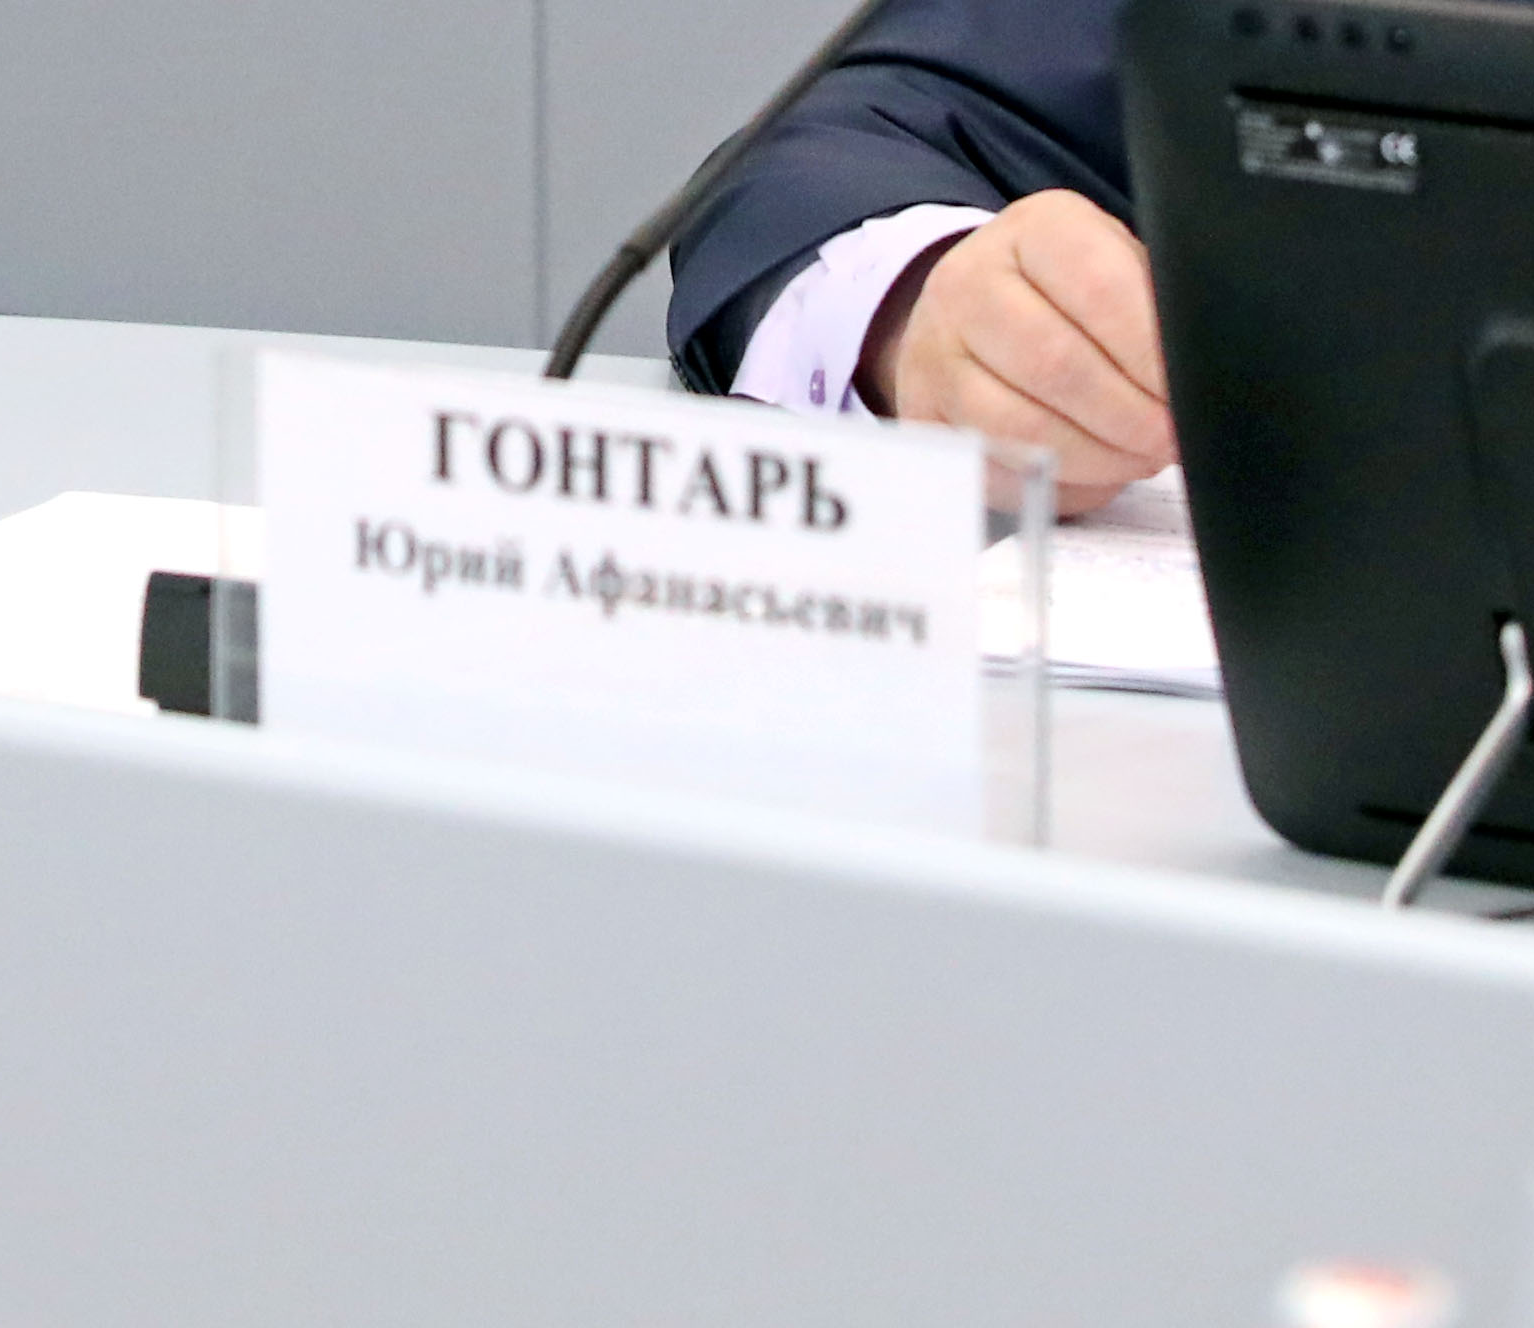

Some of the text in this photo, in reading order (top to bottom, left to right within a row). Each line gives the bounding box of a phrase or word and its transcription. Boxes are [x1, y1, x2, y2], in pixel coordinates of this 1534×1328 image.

[432, 410, 852, 533] ГОНТАРЬ
[354, 517, 930, 646] Юрий Афанасьевич
